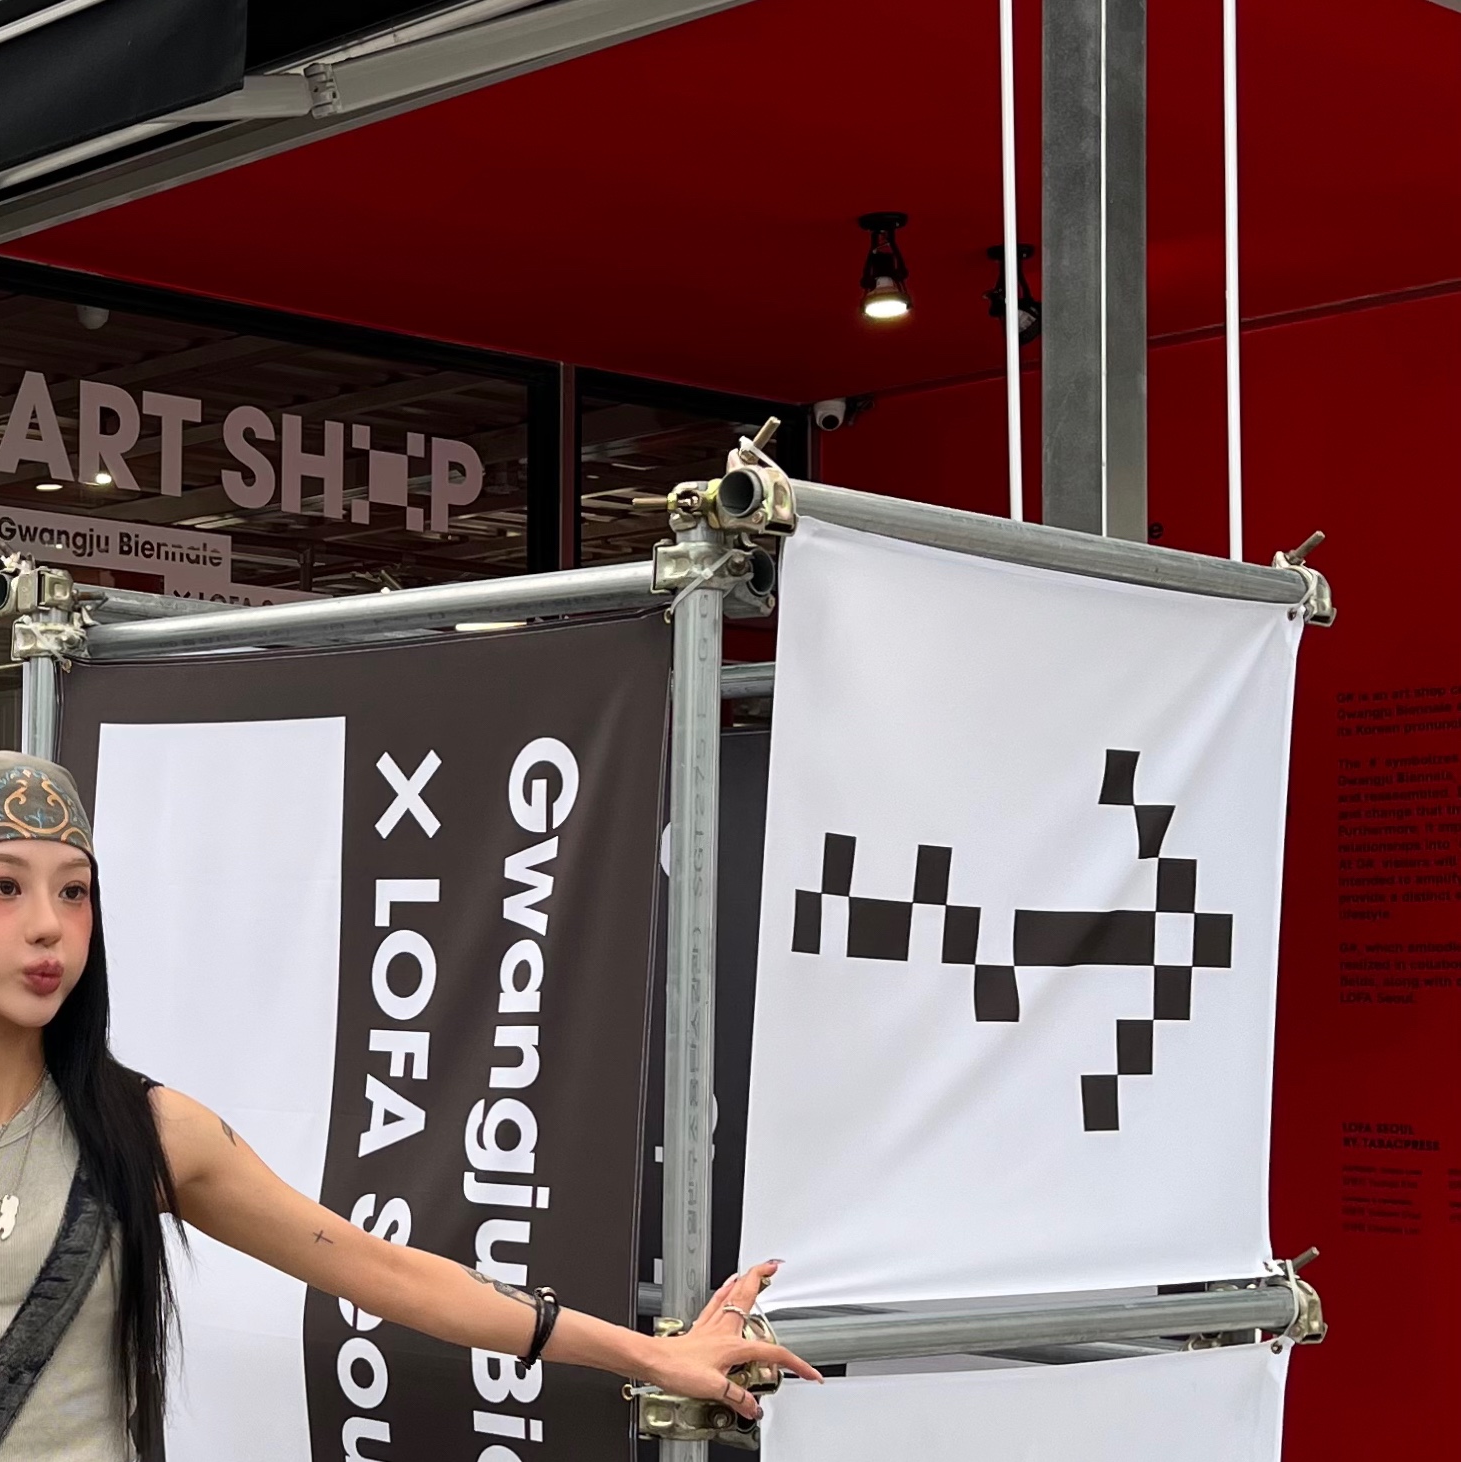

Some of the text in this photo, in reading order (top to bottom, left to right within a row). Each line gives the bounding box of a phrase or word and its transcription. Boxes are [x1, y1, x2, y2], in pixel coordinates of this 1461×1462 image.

[118, 531, 224, 568] Biennale
[374, 750, 443, 839] X
[357, 878, 442, 1160] LOFA
[463, 736, 580, 1287] Gwangju
